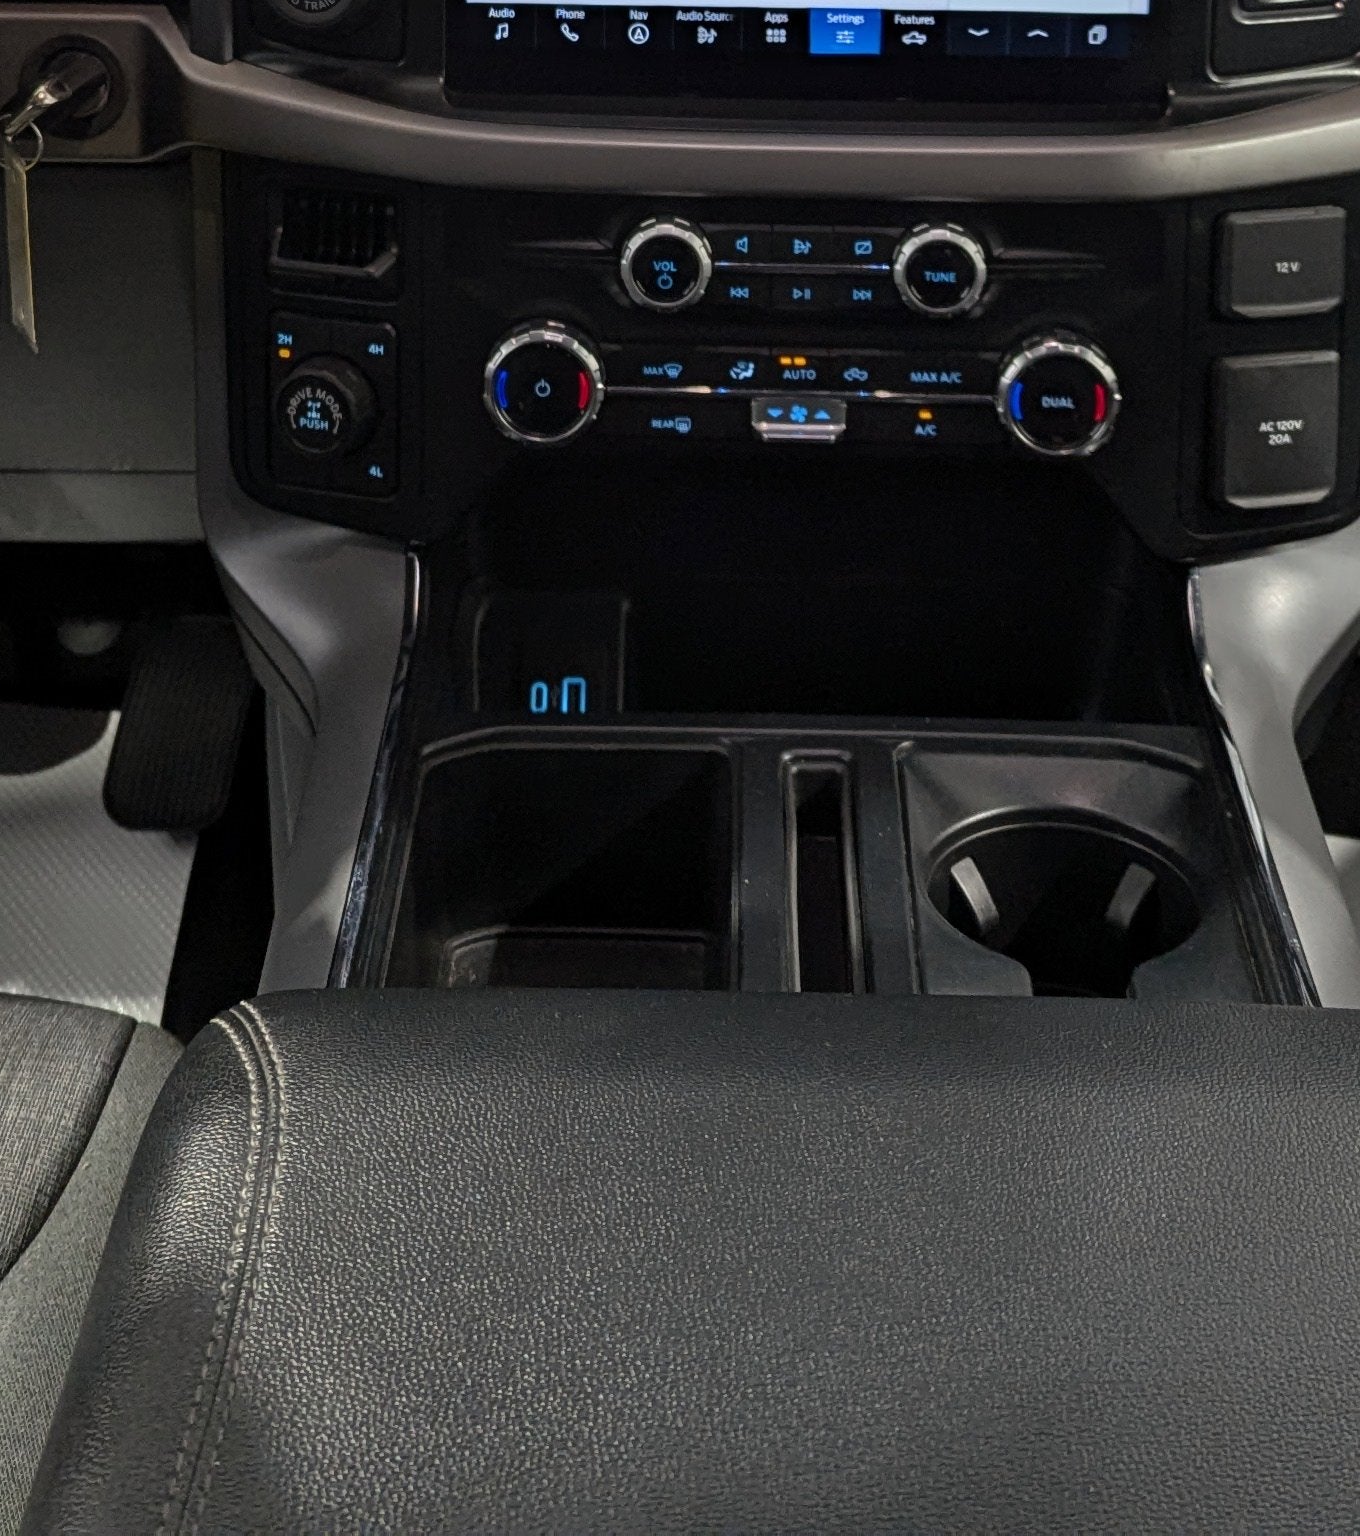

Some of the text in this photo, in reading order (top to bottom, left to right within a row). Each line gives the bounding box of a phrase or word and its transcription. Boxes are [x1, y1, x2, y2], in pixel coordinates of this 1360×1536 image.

[488, 8, 515, 19] Audio
[555, 9, 585, 20] Phone
[630, 10, 648, 21] Nav
[676, 10, 703, 21] Audio
[765, 12, 789, 24] Apps
[827, 13, 864, 26] Settings
[894, 14, 934, 26] Features
[653, 261, 677, 272] VOL
[924, 272, 956, 283] TUNE
[277, 333, 292, 345] 2H
[368, 344, 384, 355] 4H
[643, 366, 664, 375] MAX
[783, 370, 816, 380] AUTO
[910, 371, 962, 384] MAX A/C
[288, 387, 342, 420] DRIVE MODE
[1042, 396, 1074, 410] DUAL
[300, 417, 328, 430] PUSH
[651, 420, 674, 429] REAR
[1259, 420, 1303, 432] AC 120V
[915, 423, 937, 437] A/C
[1268, 434, 1292, 445] 20A
[369, 466, 383, 478] 4L
